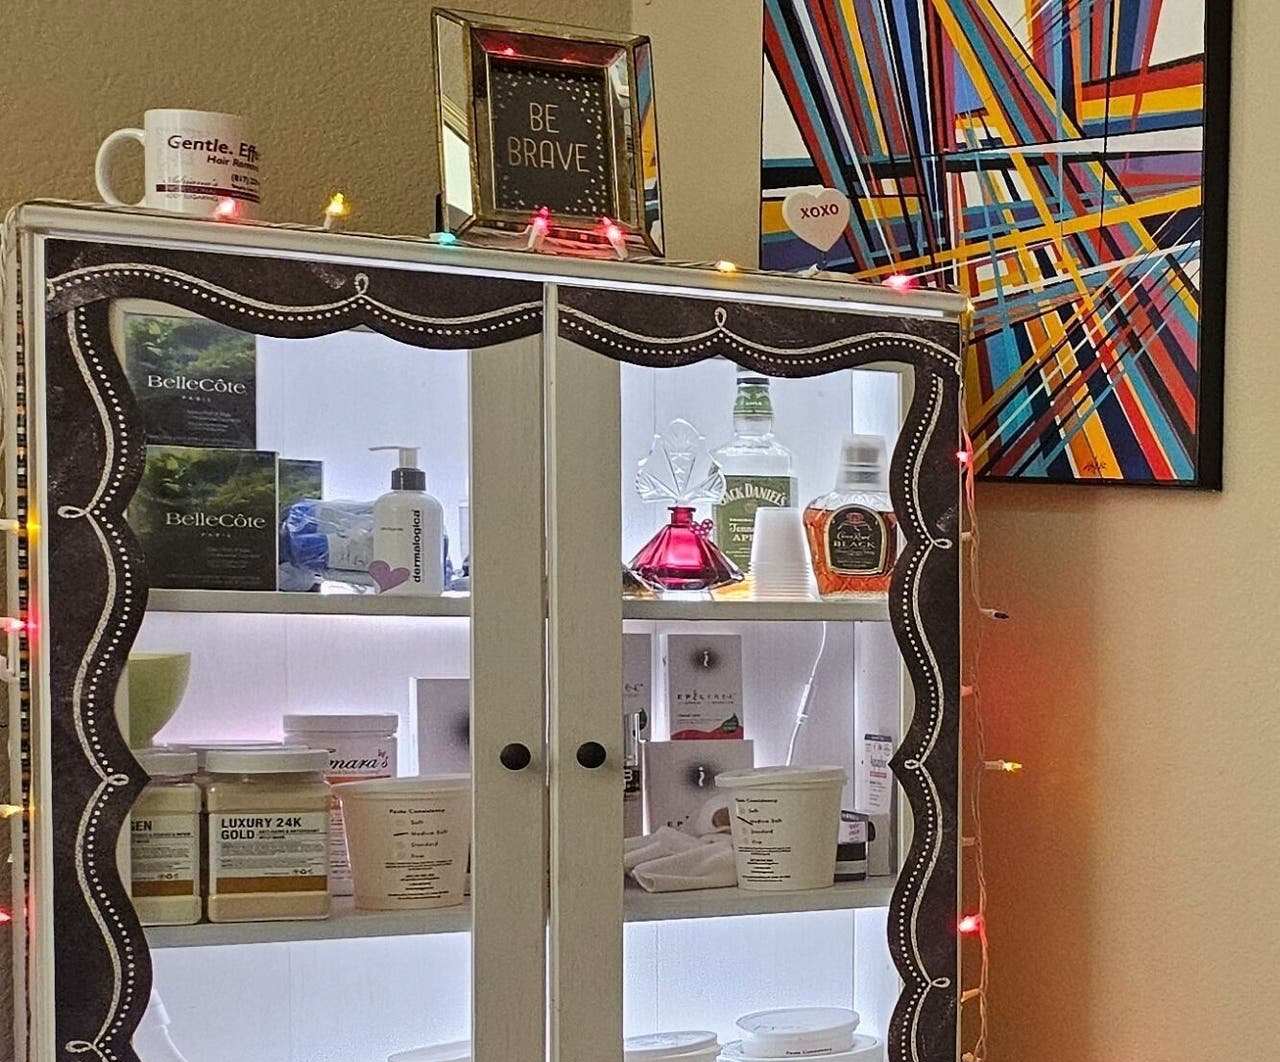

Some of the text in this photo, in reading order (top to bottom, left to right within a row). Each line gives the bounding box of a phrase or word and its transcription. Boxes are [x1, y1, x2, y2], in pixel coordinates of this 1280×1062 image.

[529, 102, 560, 134] BE
[168, 135, 233, 155] Gentle.
[507, 136, 590, 173] BRAVE
[800, 203, 839, 220] XOXO
[148, 375, 247, 395] BelleCôte
[166, 511, 266, 529] BelleCôte
[413, 509, 422, 583] dermalogica
[330, 753, 389, 769] mara's
[221, 817, 302, 828] LUXURY 24K
[221, 829, 255, 840] GOLD
